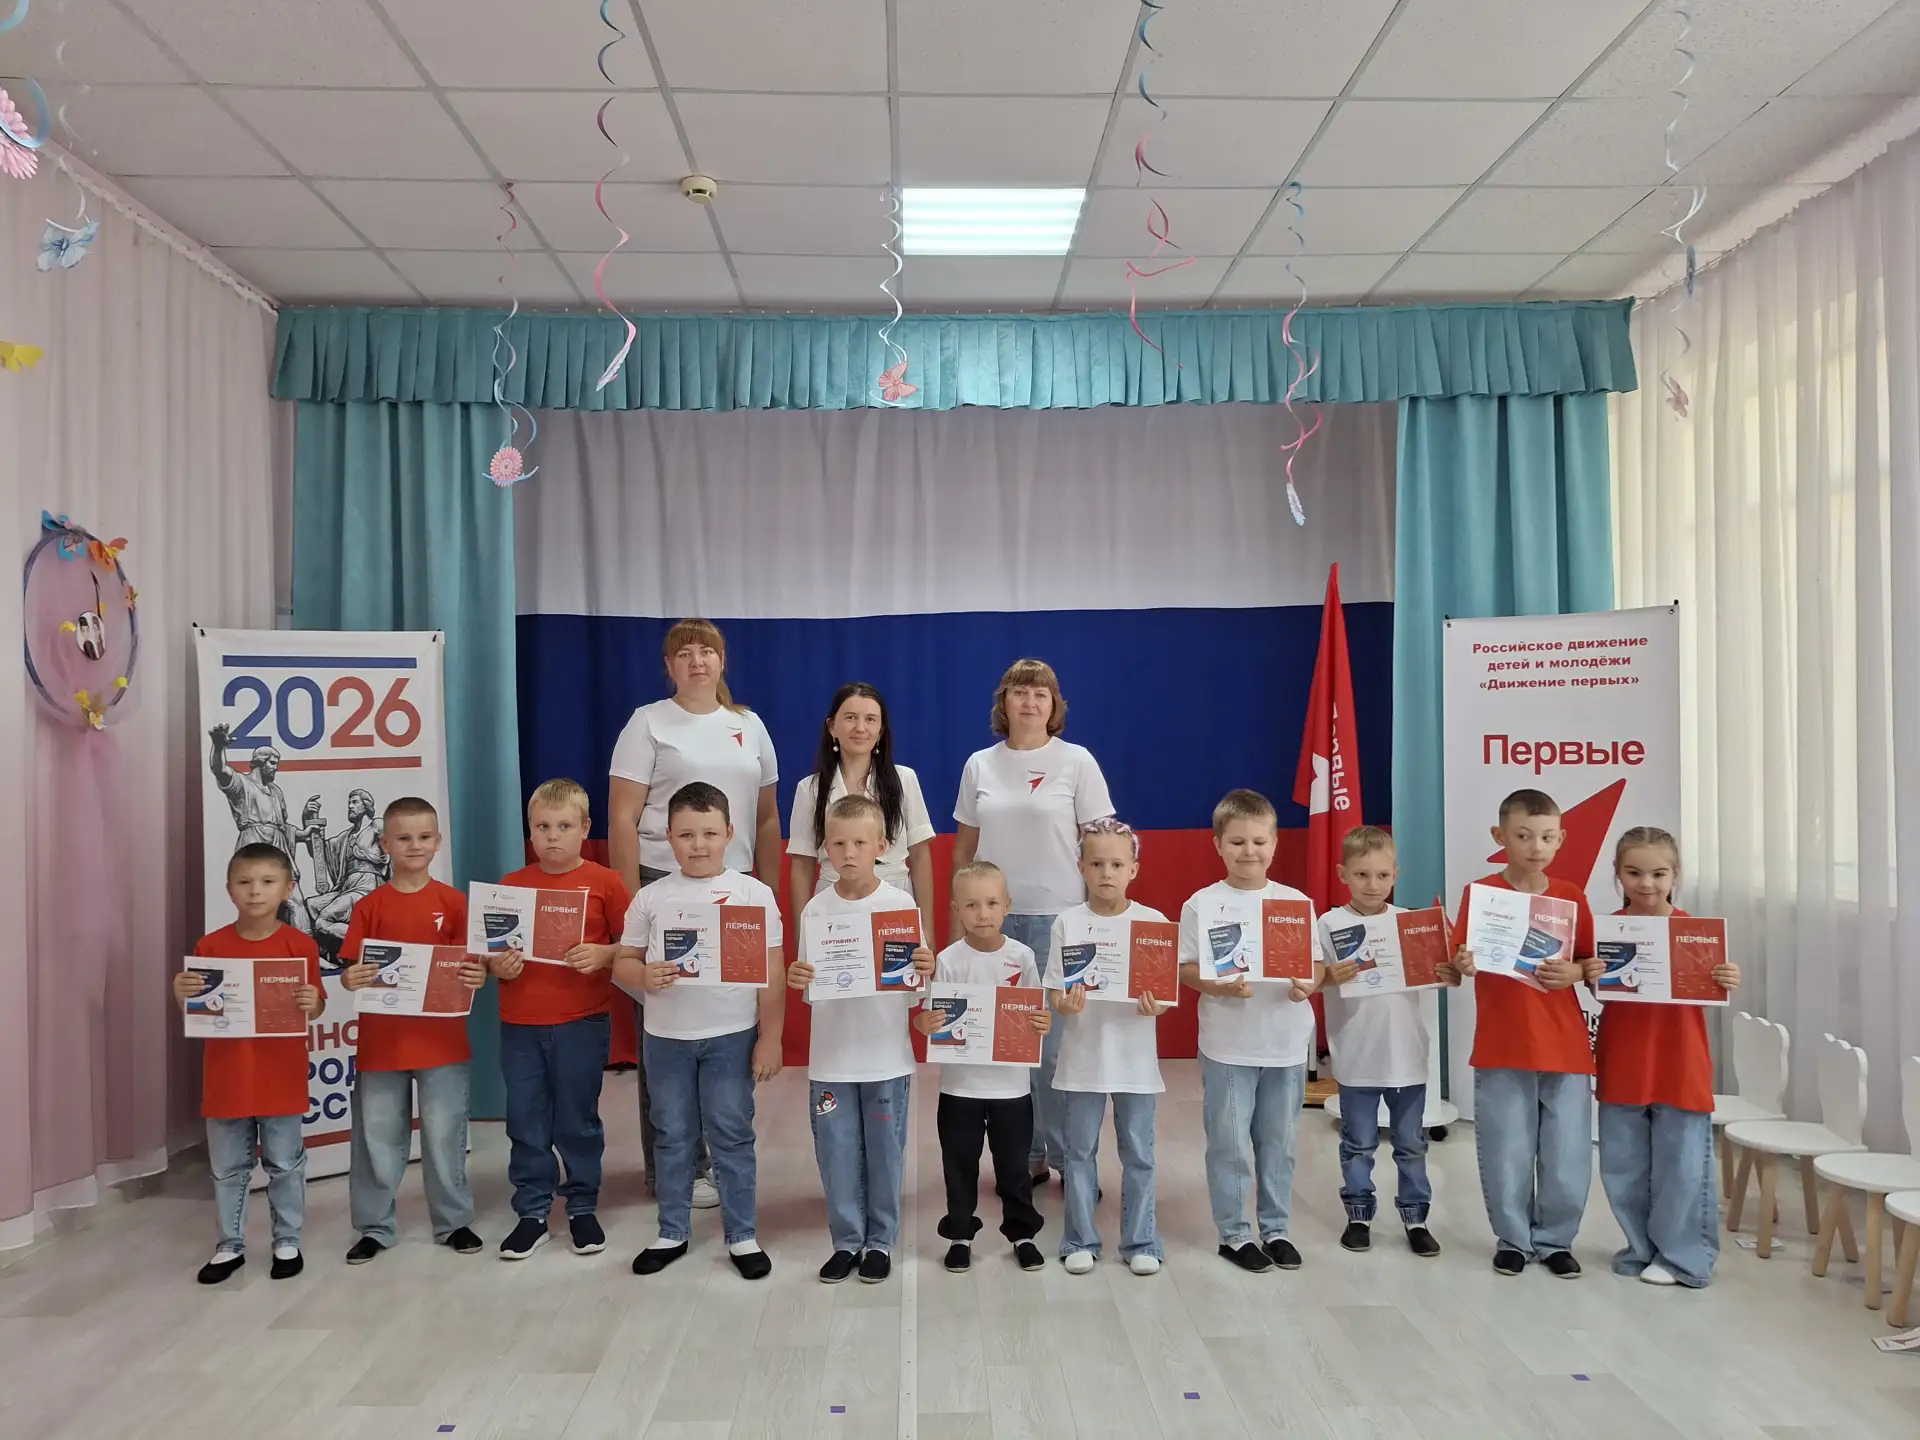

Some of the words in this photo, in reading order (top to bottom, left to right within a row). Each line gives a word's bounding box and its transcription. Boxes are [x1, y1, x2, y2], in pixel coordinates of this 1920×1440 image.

[1472, 641, 1563, 653] Российское
[1568, 637, 1648, 651] движение
[1487, 659, 1530, 672] детей
[1535, 660, 1544, 668] и
[1549, 656, 1631, 668] молодёжи
[1480, 678, 1566, 690] «Движение
[1571, 676, 1639, 688] первых»
[222, 675, 422, 750] 2026
[1483, 734, 1645, 775] Первые
[541, 905, 579, 913] ПЕРВЫЕ
[1268, 916, 1306, 924] ПЕРВЫЕ
[1535, 913, 1569, 925] ПЕРВЫЕ
[725, 922, 761, 930] ПЕРВЫЕ
[878, 926, 915, 936] ПЕРВЫЕ
[1404, 924, 1439, 935] ПЕРВЫЕ
[821, 938, 859, 946] СЕРТИФИКАТ
[1135, 937, 1173, 947] ПЕРВЫЕ
[1676, 935, 1719, 944] ПЕРВЫЕ
[260, 976, 299, 984] ПЕРВЫЕ
[1001, 1003, 1038, 1011] ПЕРВЫЕ
